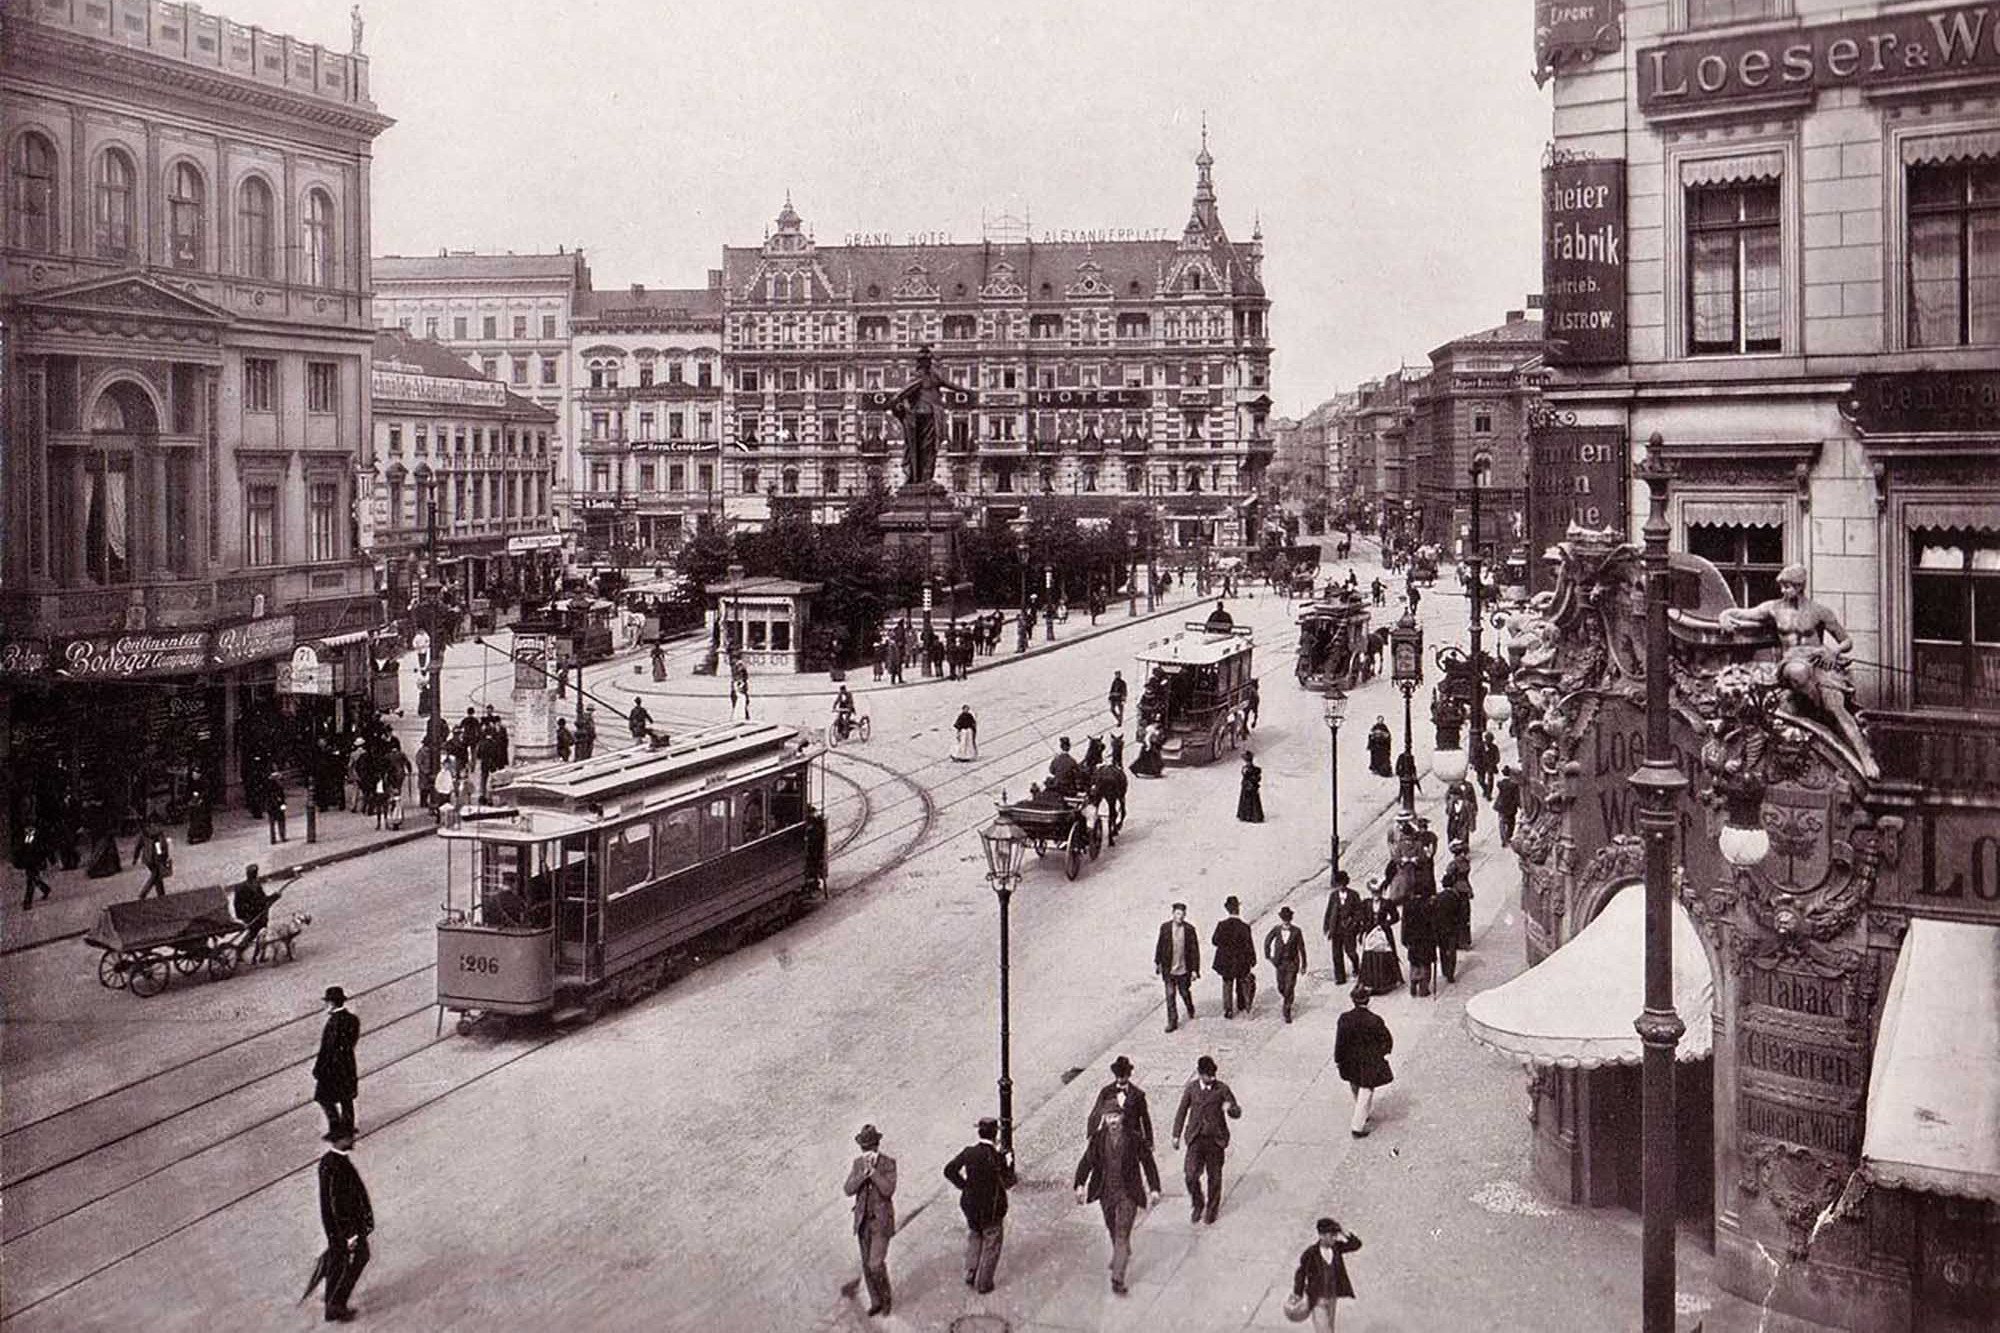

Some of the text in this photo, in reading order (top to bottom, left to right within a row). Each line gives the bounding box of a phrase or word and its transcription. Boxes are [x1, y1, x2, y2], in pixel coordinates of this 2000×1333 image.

[1650, 8, 2000, 98] Loeser & W
[1038, 391, 1130, 404] HOTEL
[116, 634, 202, 652] Continental
[57, 641, 150, 678] Bodega
